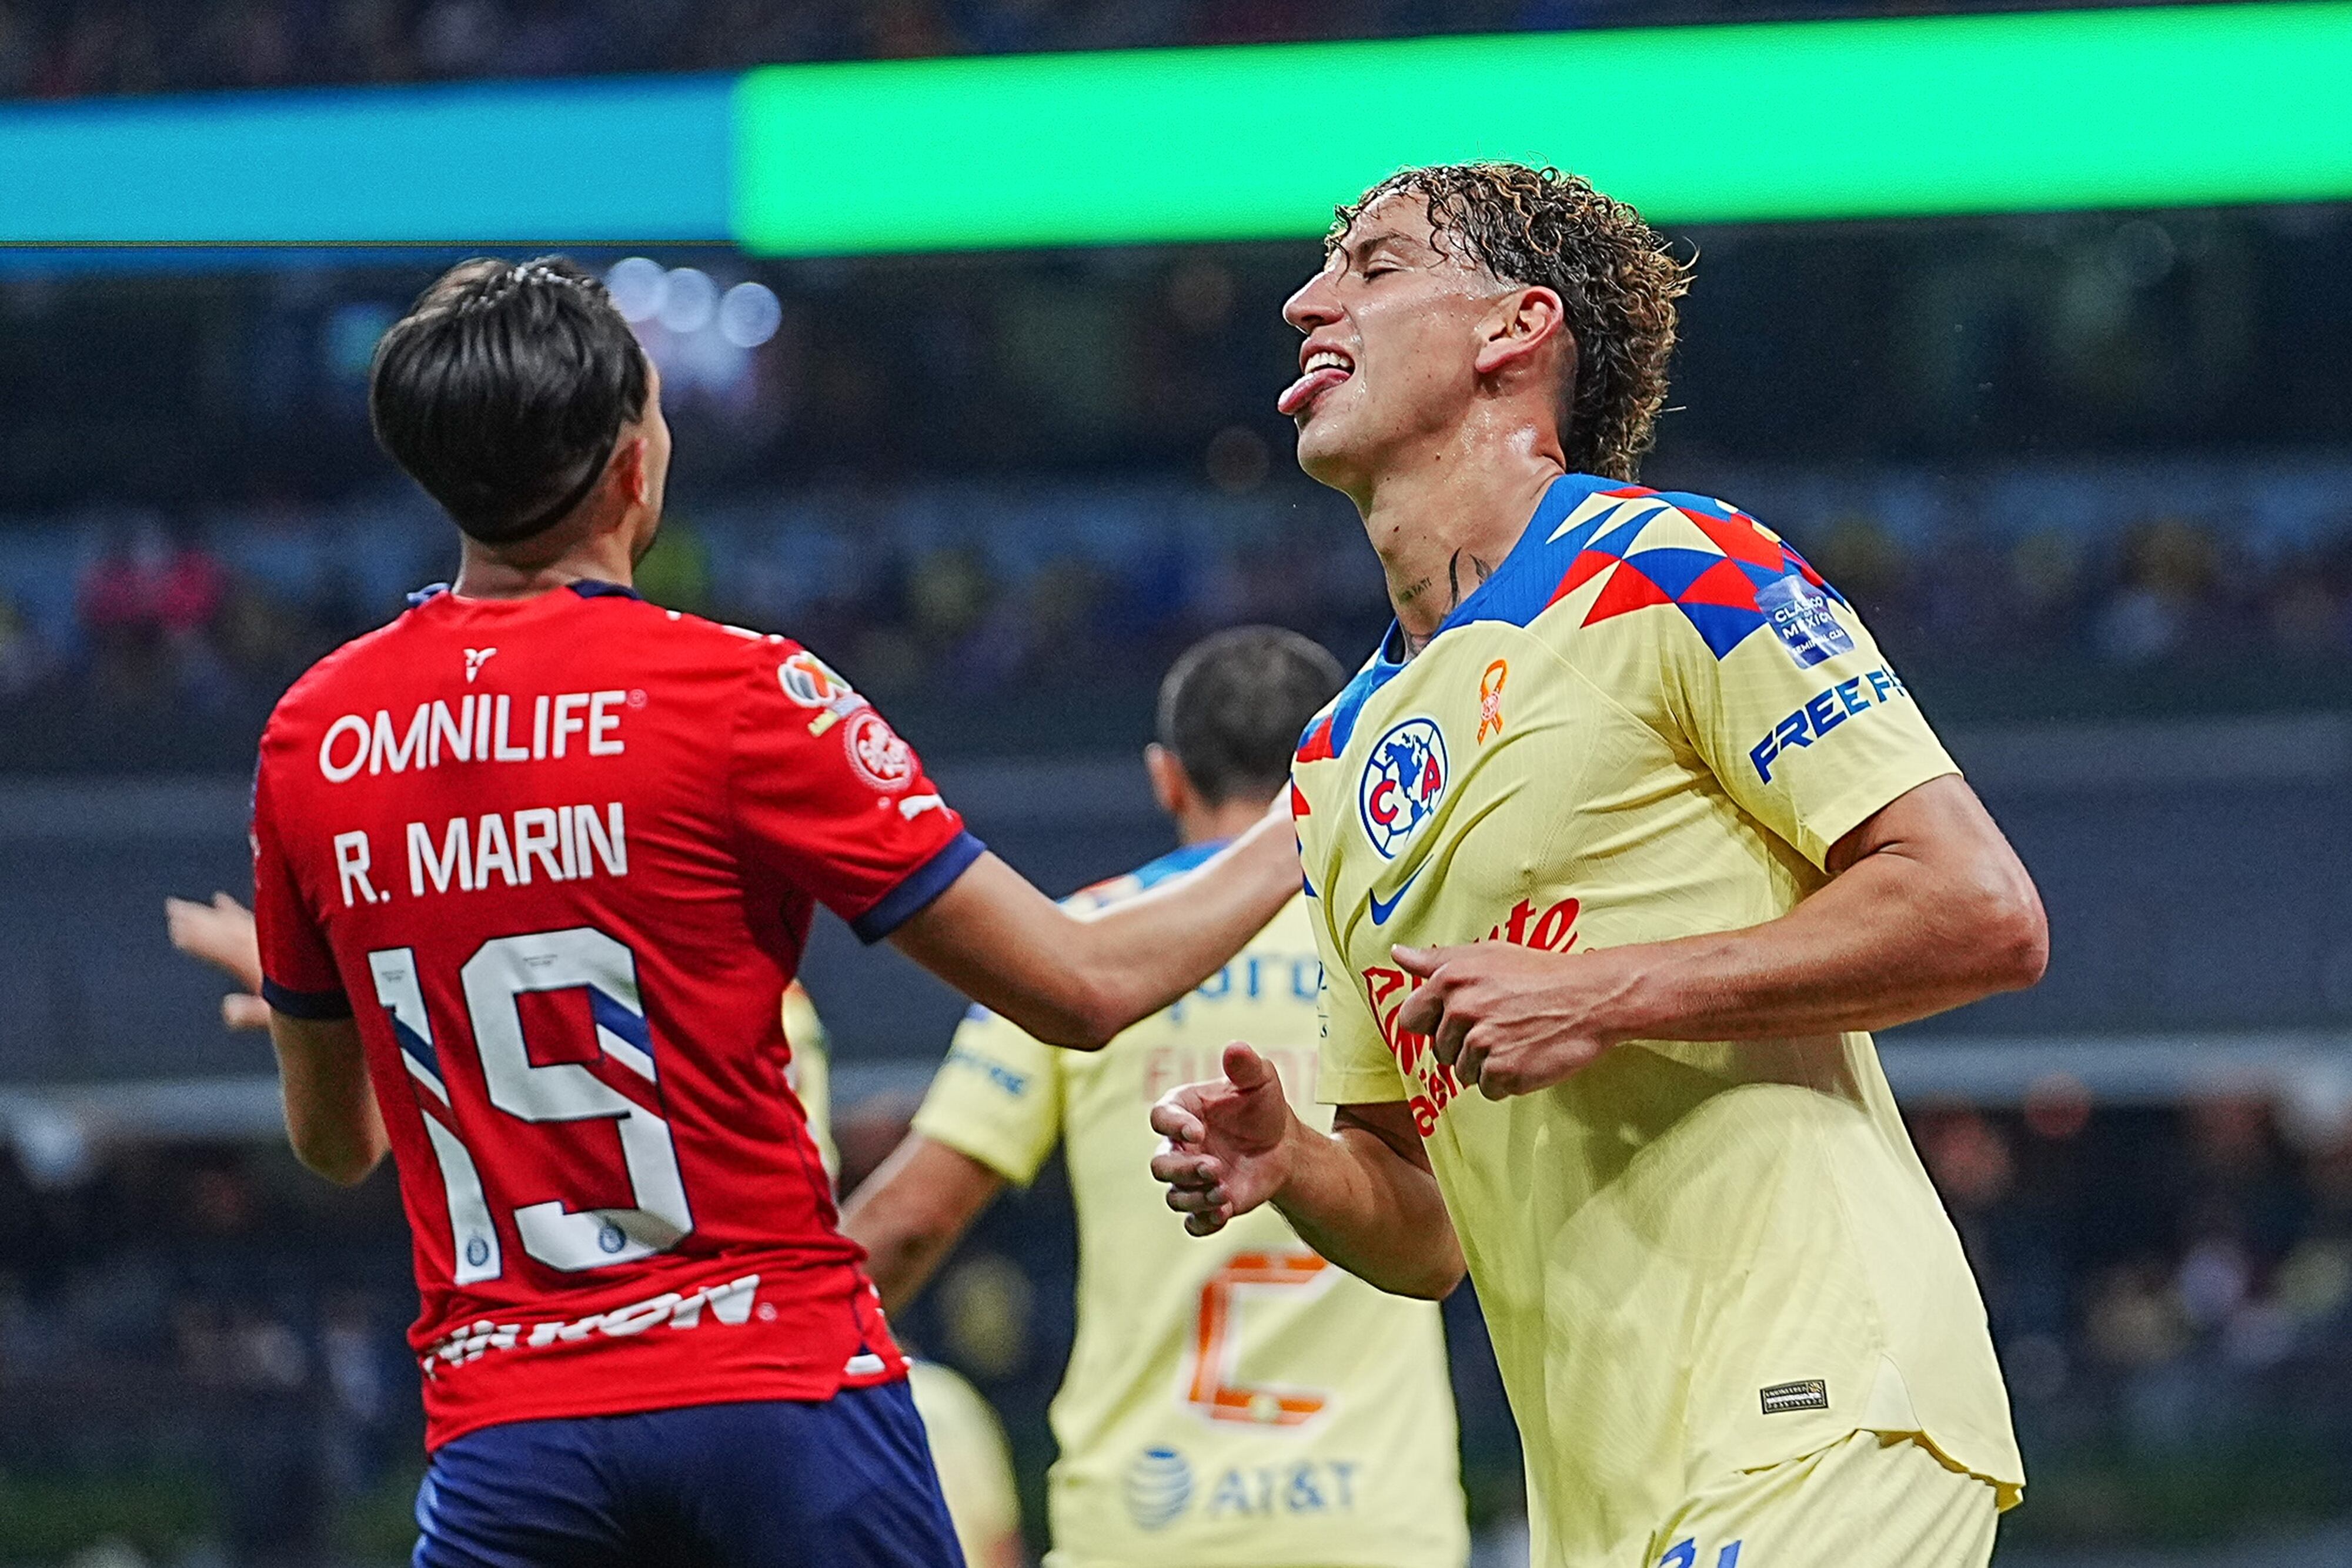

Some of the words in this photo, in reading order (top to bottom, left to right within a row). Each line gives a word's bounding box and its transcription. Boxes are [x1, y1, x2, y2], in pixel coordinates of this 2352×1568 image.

[319, 690, 626, 783] OMNILIFE
[1749, 676, 1871, 785] FREE
[334, 830, 390, 907] R.
[406, 802, 628, 897] MARIN
[368, 927, 695, 1286] 19
[1209, 1460, 1362, 1517] AT&T
